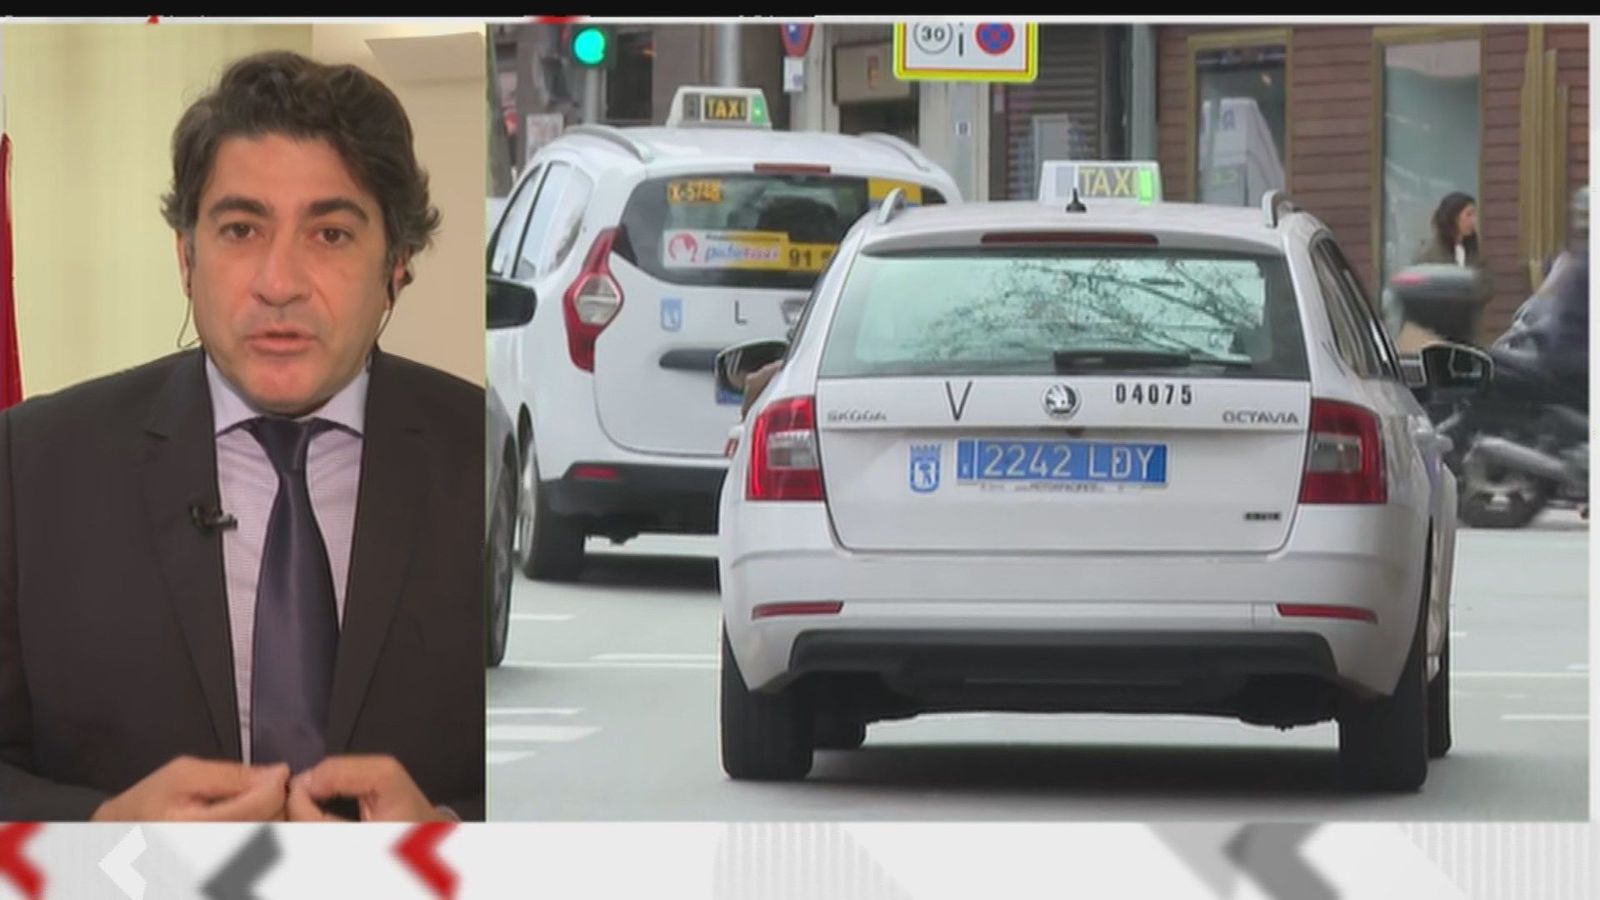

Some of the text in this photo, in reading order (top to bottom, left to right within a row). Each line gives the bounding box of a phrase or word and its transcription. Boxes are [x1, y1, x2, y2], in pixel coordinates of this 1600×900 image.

[922, 27, 944, 41] 30
[706, 96, 746, 119] TAXI
[1079, 167, 1139, 196] TAXI
[735, 300, 747, 325] L
[945, 380, 972, 421] V
[1115, 383, 1192, 405] 04075
[1222, 410, 1298, 424] OCTAVIA
[983, 444, 1071, 477] 2242
